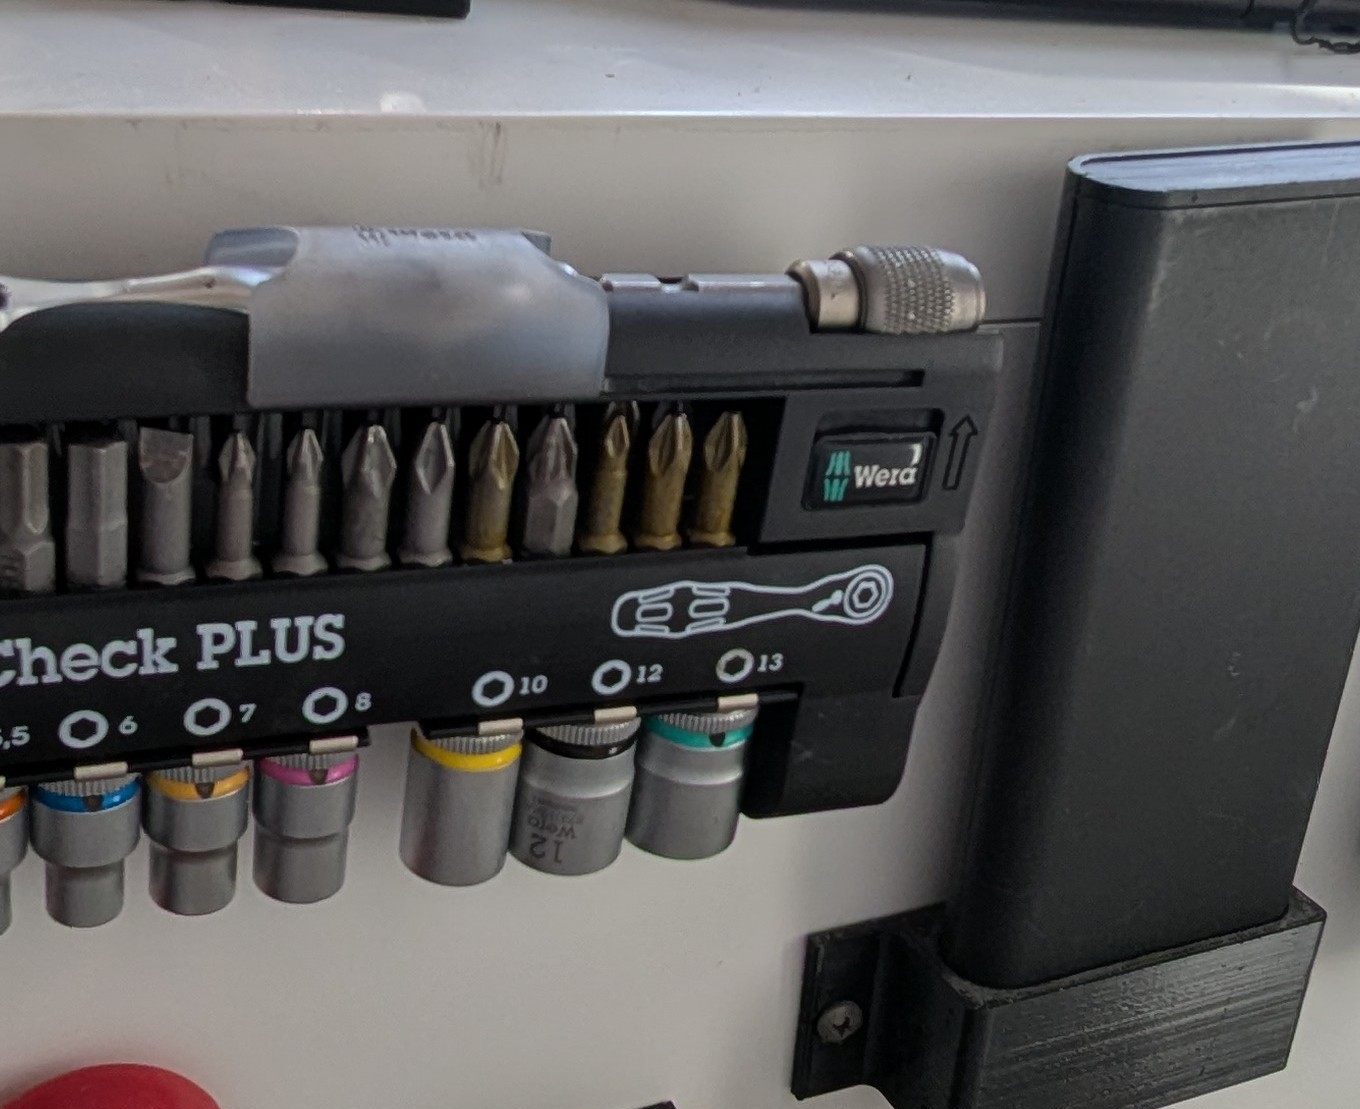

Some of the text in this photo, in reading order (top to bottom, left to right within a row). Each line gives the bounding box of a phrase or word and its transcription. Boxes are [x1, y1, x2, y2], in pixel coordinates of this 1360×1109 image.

[853, 463, 918, 489] Wera
[196, 613, 346, 671] PLUS
[756, 653, 784, 673] 13
[518, 674, 548, 695] 10
[636, 664, 664, 684] 12
[354, 692, 372, 712] 8
[239, 703, 257, 724] 7
[118, 715, 138, 736] 6
[529, 832, 564, 865] 12
